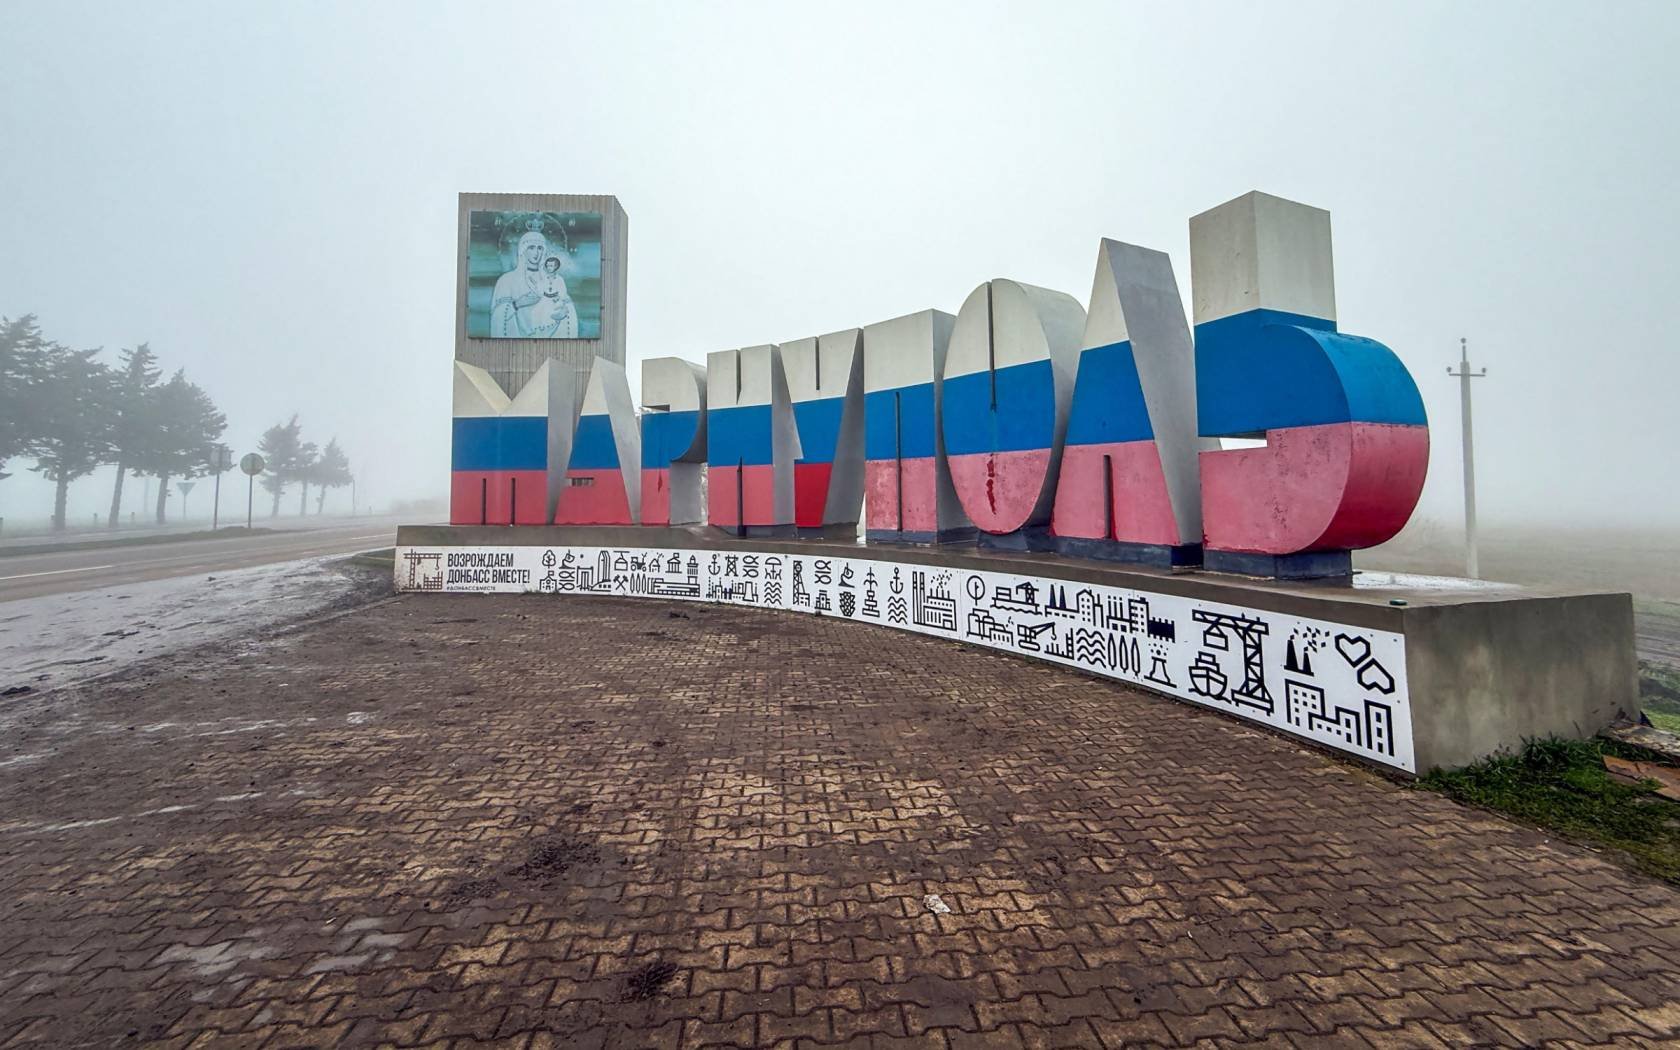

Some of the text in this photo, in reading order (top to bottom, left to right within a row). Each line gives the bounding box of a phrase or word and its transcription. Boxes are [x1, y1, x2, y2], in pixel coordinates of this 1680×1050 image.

[450, 191, 1430, 557] МАРИУПОЛЬ
[447, 553, 514, 568] ВОЗРОЖДАЕМ
[446, 569, 531, 584] ДОНБАСС ВМЕСТЕ!
